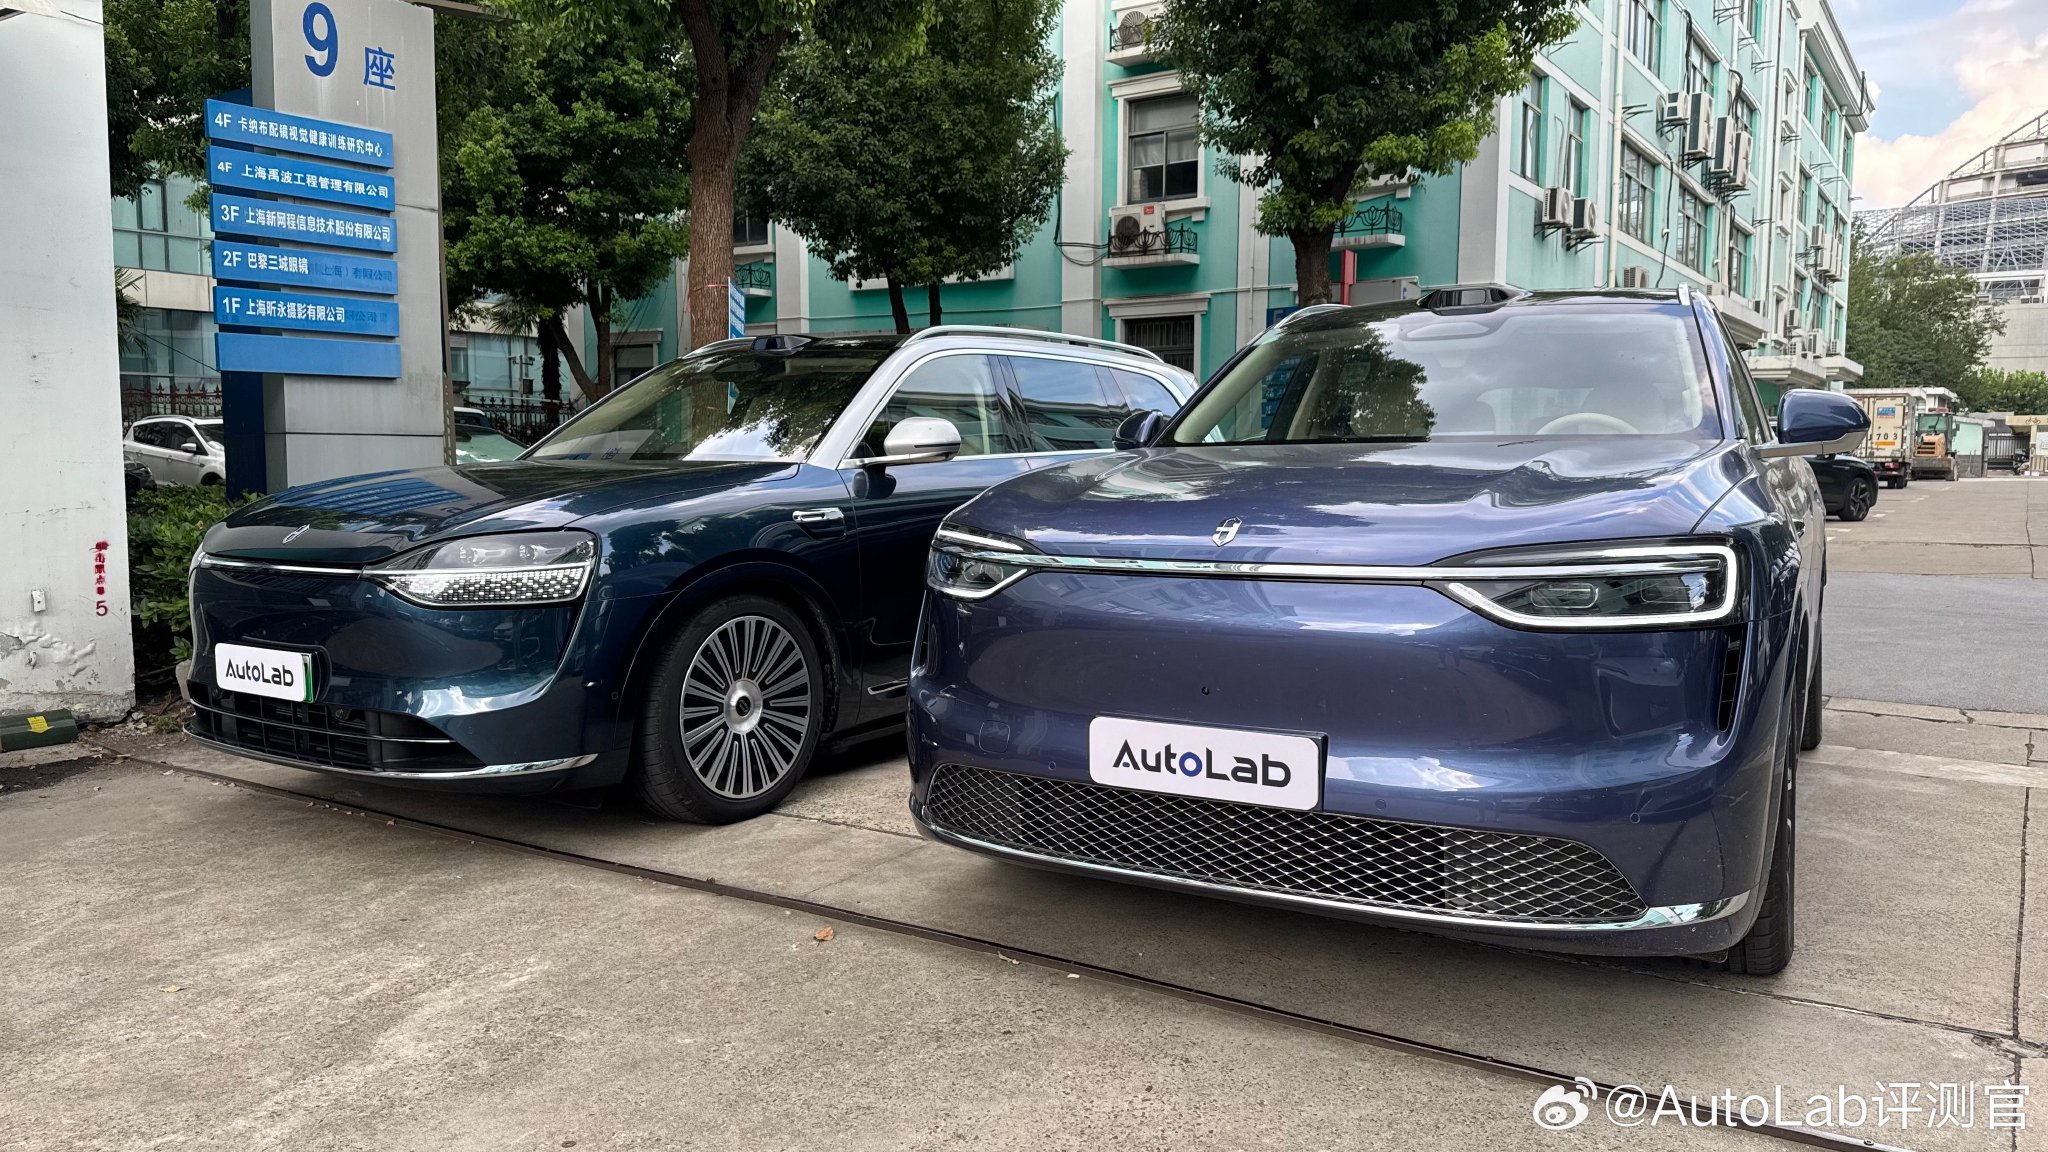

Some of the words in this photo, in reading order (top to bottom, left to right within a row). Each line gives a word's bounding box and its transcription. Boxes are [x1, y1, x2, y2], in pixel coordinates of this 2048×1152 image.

[302, 2, 339, 78] 9
[362, 46, 397, 91] 座
[214, 112, 232, 128] 4F
[238, 116, 383, 157] 卡纳布配镜视觉健康训练研究中心
[217, 161, 233, 173] 4F
[241, 164, 388, 199] 上海禹波工程管理有限公司
[220, 204, 240, 222] 3F
[245, 206, 391, 242] 上海新网程信息技术股份有限公司
[223, 250, 242, 267] 2F
[247, 252, 309, 275] 巴黎三城眼镜
[222, 297, 241, 314] 1F
[245, 298, 345, 323] 上海昕永摄影有限公司
[95, 600, 108, 617] 5
[225, 658, 294, 687] AutoLab
[1112, 739, 1292, 788] AutoLab
